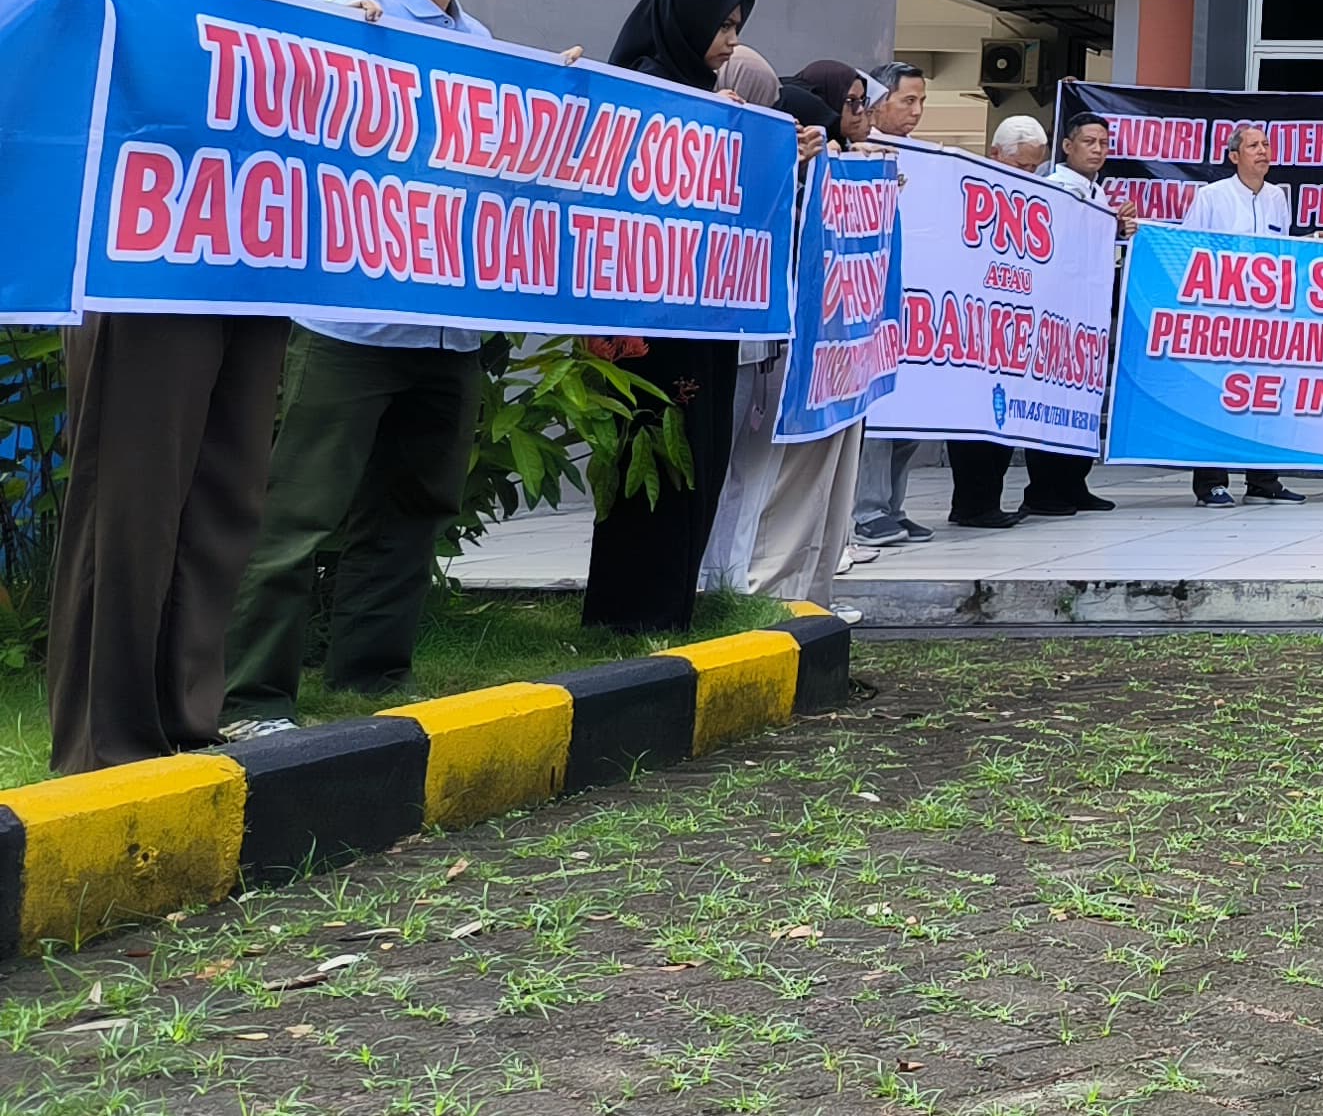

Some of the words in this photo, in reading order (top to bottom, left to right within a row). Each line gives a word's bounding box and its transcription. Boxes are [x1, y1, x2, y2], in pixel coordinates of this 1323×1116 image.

[203, 24, 417, 156] TUNTUT
[434, 79, 640, 190] KEADILAN
[633, 120, 741, 209] SOSIAL
[1102, 116, 1203, 162] ENDIRI
[115, 150, 304, 261] BAGI
[323, 171, 463, 280] DOSEN
[478, 199, 557, 290] DAN
[570, 212, 700, 300] TENDIK
[704, 227, 771, 305] KAMI
[962, 182, 1052, 259] PNS
[984, 266, 1032, 293] ATAU
[1180, 251, 1295, 308] AKSI
[987, 304, 1033, 372] KE
[1222, 373, 1284, 410] SE
